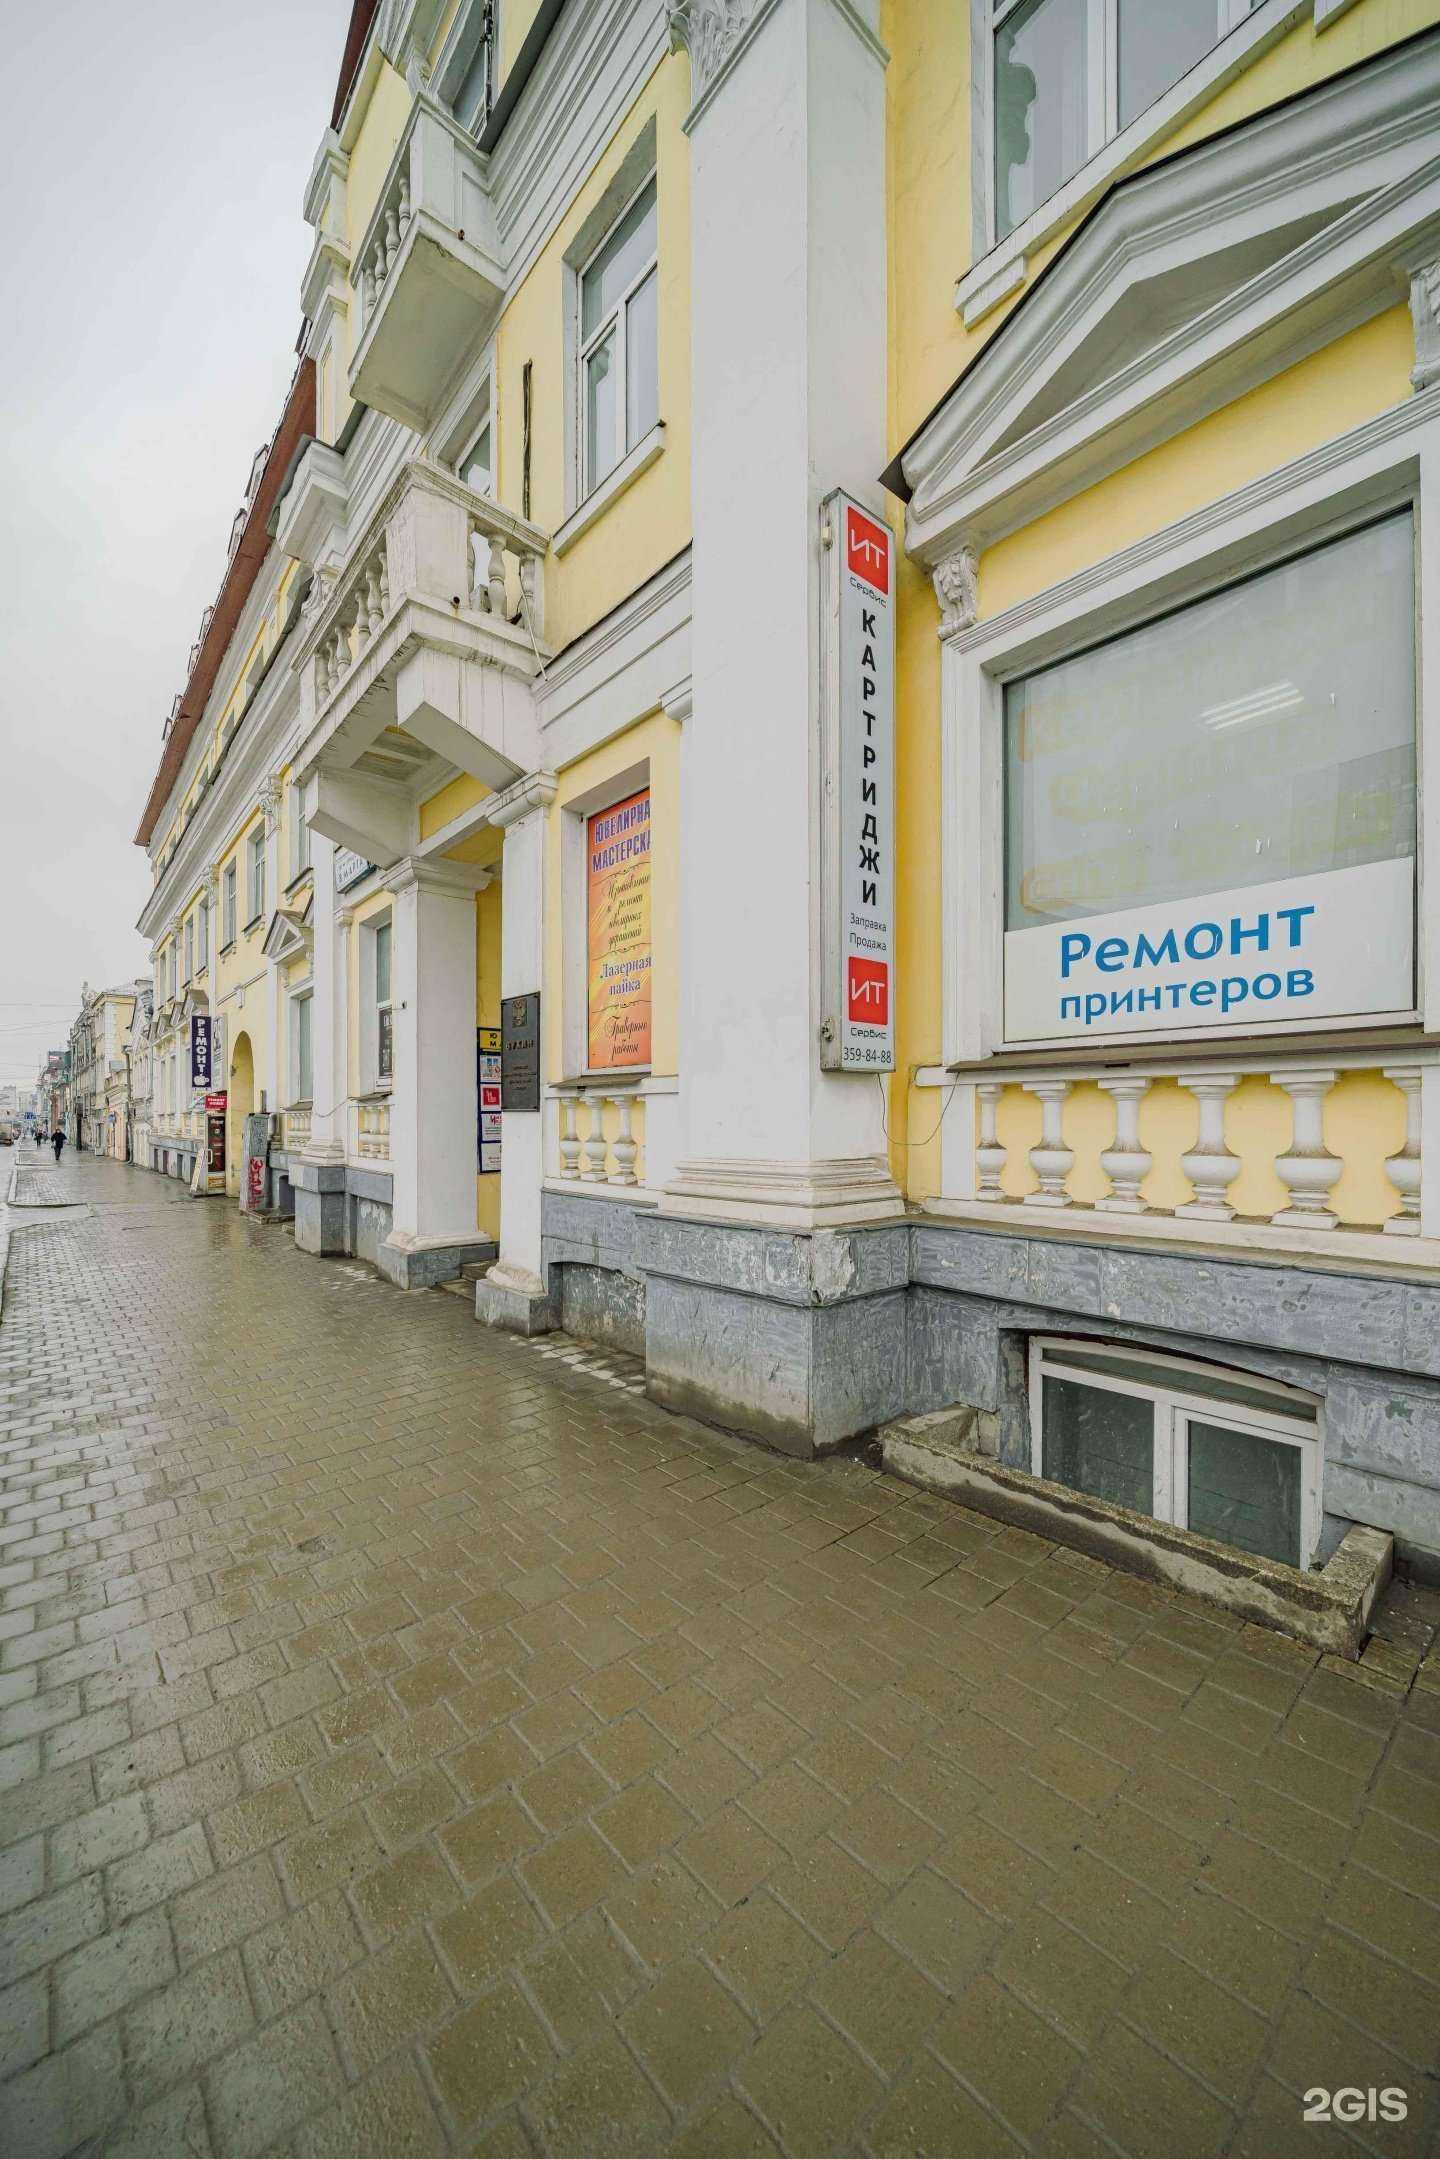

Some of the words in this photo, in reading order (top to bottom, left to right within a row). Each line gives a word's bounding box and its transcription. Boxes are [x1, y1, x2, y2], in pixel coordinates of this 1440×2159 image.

[851, 528, 886, 569] ИТ
[850, 576, 887, 608] Сервис
[859, 608, 880, 906] КАРТРИДЖИ
[850, 912, 887, 932] Заправка
[849, 932, 887, 951] Продажа
[1060, 905, 1315, 978] Ремонт
[600, 956, 651, 979] Лазерная
[609, 978, 641, 996] пайка
[851, 977, 885, 1004] ИТ
[1060, 968, 1316, 1024] принтеров
[195, 1018, 208, 1073] РЕМОНТ
[850, 1026, 887, 1040] Сервис
[843, 1046, 892, 1065] 359-84-88
